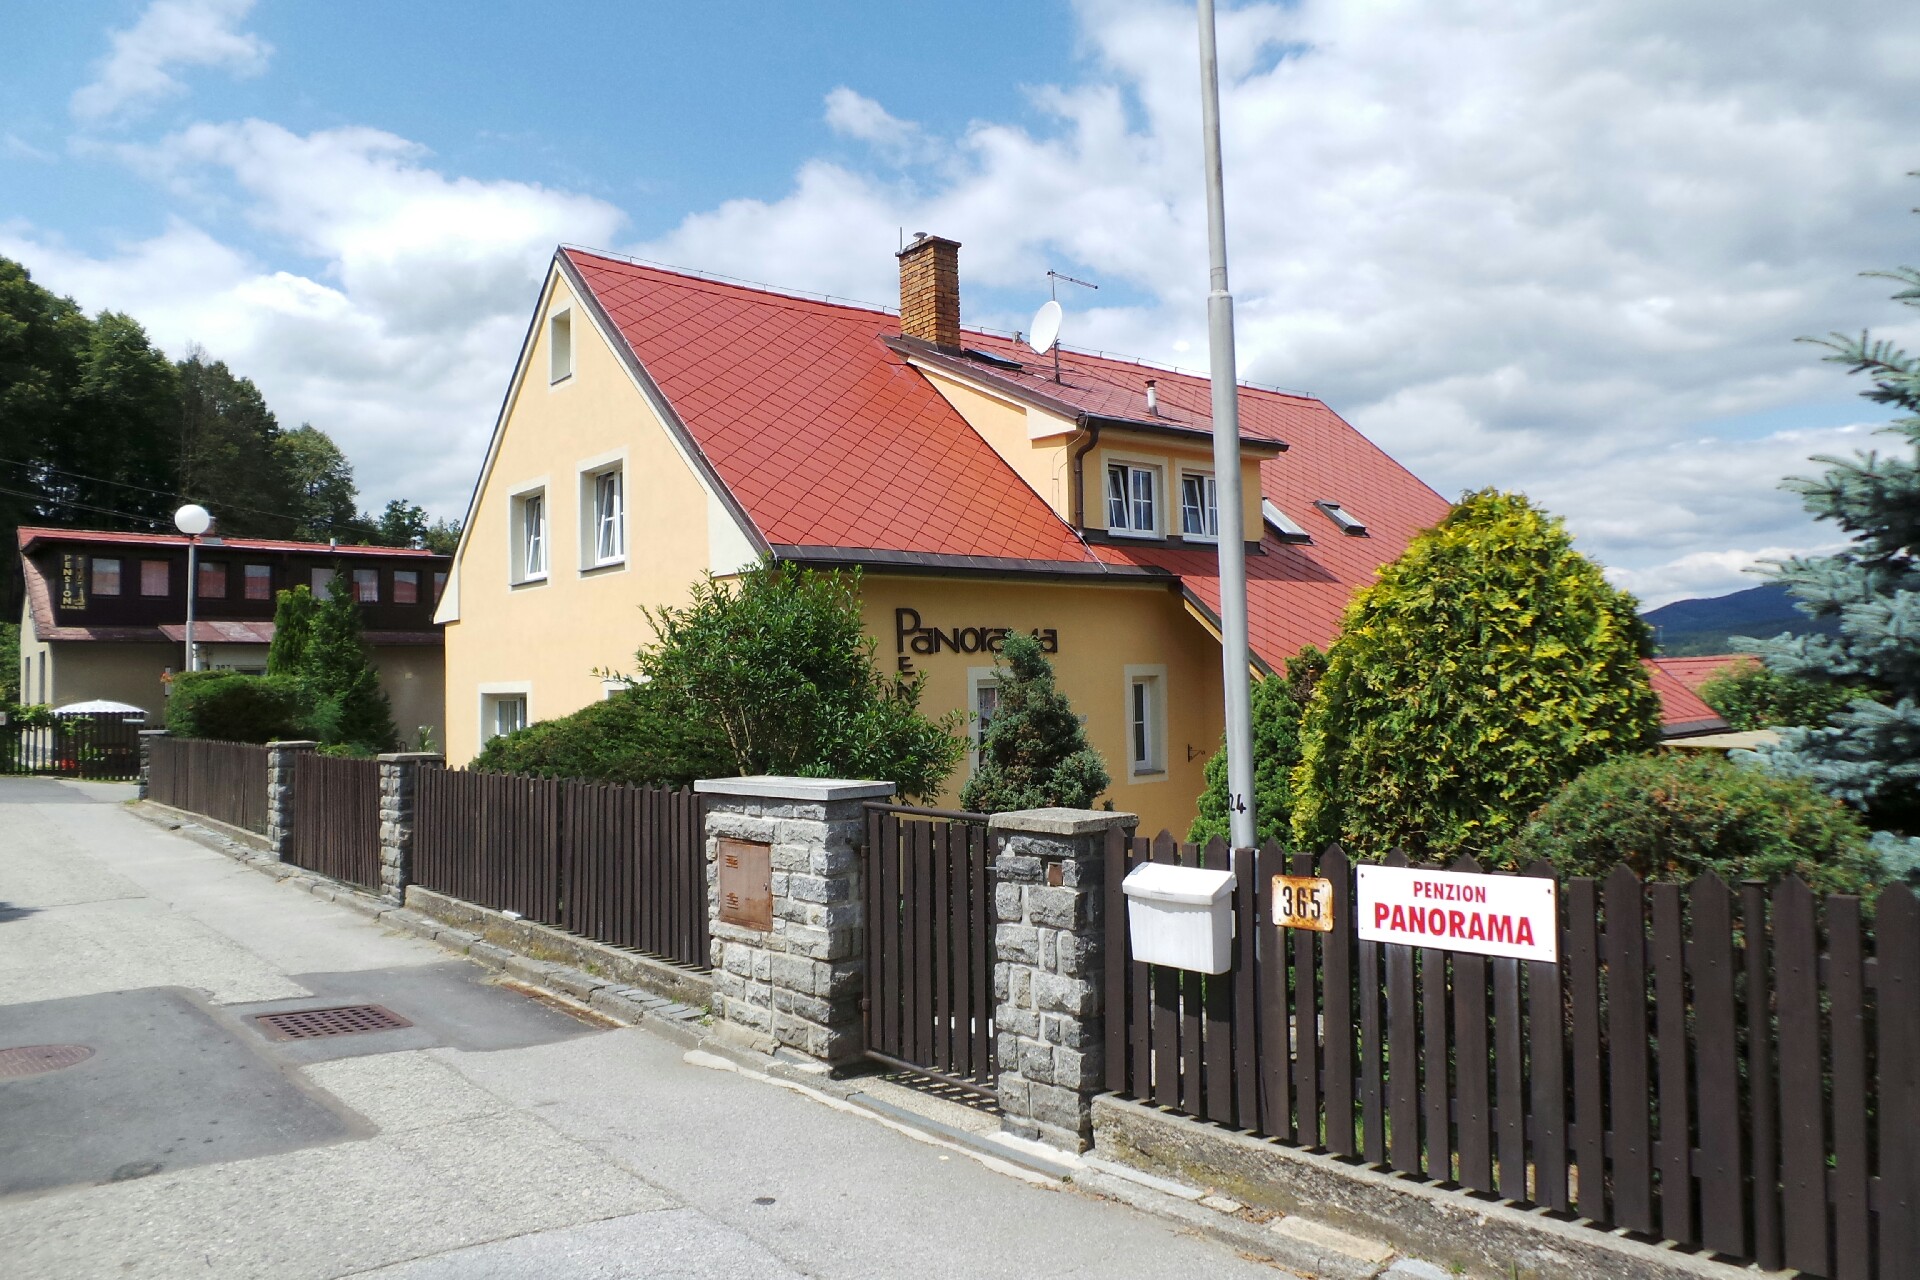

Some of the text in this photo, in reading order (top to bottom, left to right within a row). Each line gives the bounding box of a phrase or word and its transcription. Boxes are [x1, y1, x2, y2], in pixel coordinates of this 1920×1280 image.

[63, 554, 72, 605] PENSION
[1283, 886, 1321, 920] 365
[1413, 881, 1486, 903] PENZION
[1374, 902, 1535, 946] PANORAMA
